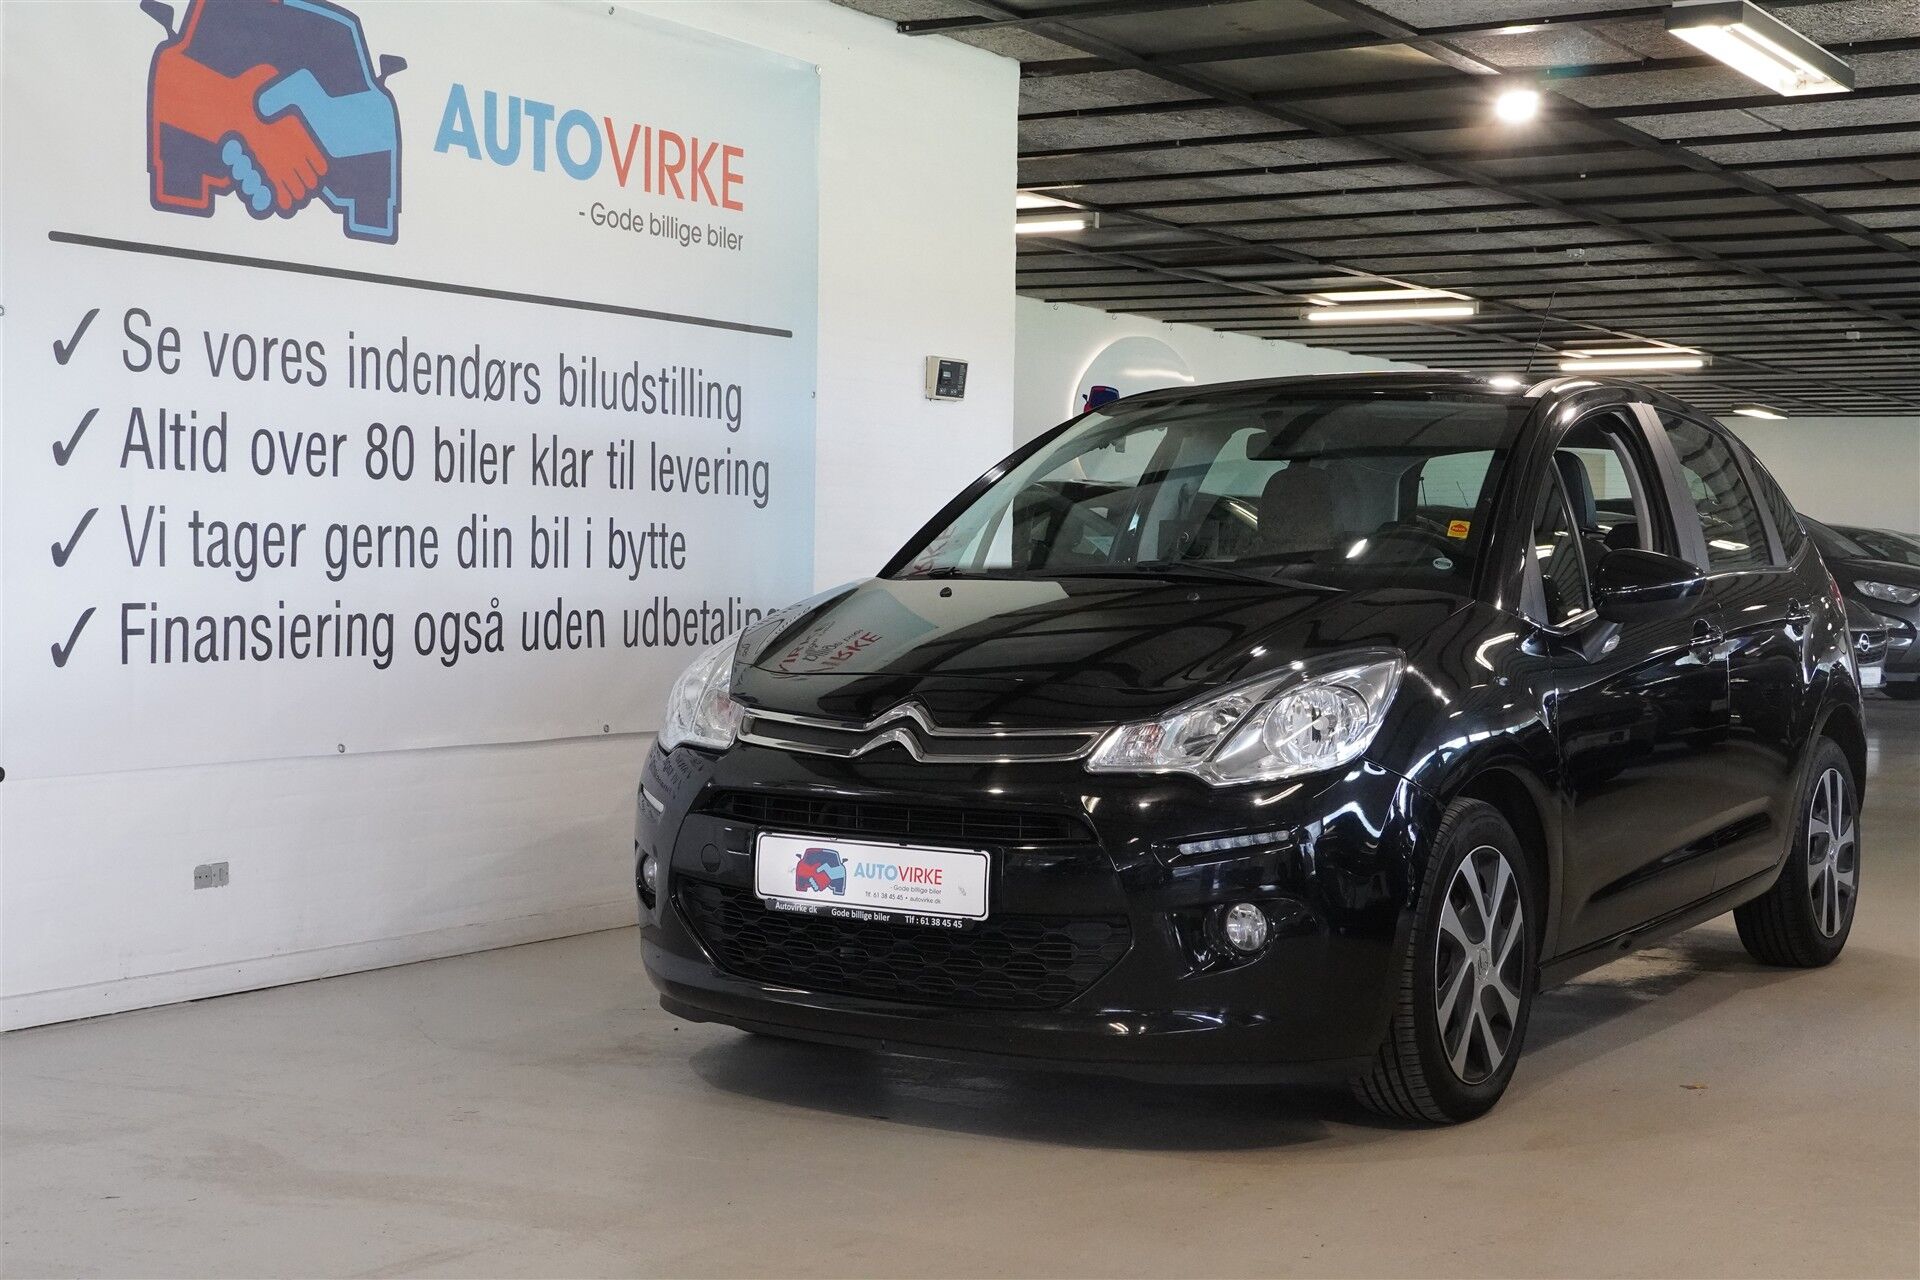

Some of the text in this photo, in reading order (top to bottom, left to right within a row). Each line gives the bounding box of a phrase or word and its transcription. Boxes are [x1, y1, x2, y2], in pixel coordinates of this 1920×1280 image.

[433, 82, 744, 212] AUTOVIRKE
[590, 202, 644, 233] Gode
[649, 212, 702, 247] billige
[707, 223, 744, 251] biler
[122, 307, 742, 433] Se vores indendørs biludstilling
[120, 406, 770, 509] Altid over 80 biler klar til levering
[120, 504, 687, 583] Vi tager gerne din bil i bytte
[120, 600, 395, 671] Finansiering
[414, 597, 505, 668] også
[521, 597, 606, 652] uden
[853, 862, 943, 885] AUTOVIRKE
[893, 884, 910, 892] Gode
[831, 908, 850, 918] Gode
[851, 909, 872, 921] billige
[873, 912, 890, 922] biler
[920, 916, 930, 926] 61
[931, 917, 941, 927] 38
[941, 919, 952, 928] 45
[952, 920, 963, 929] 45
